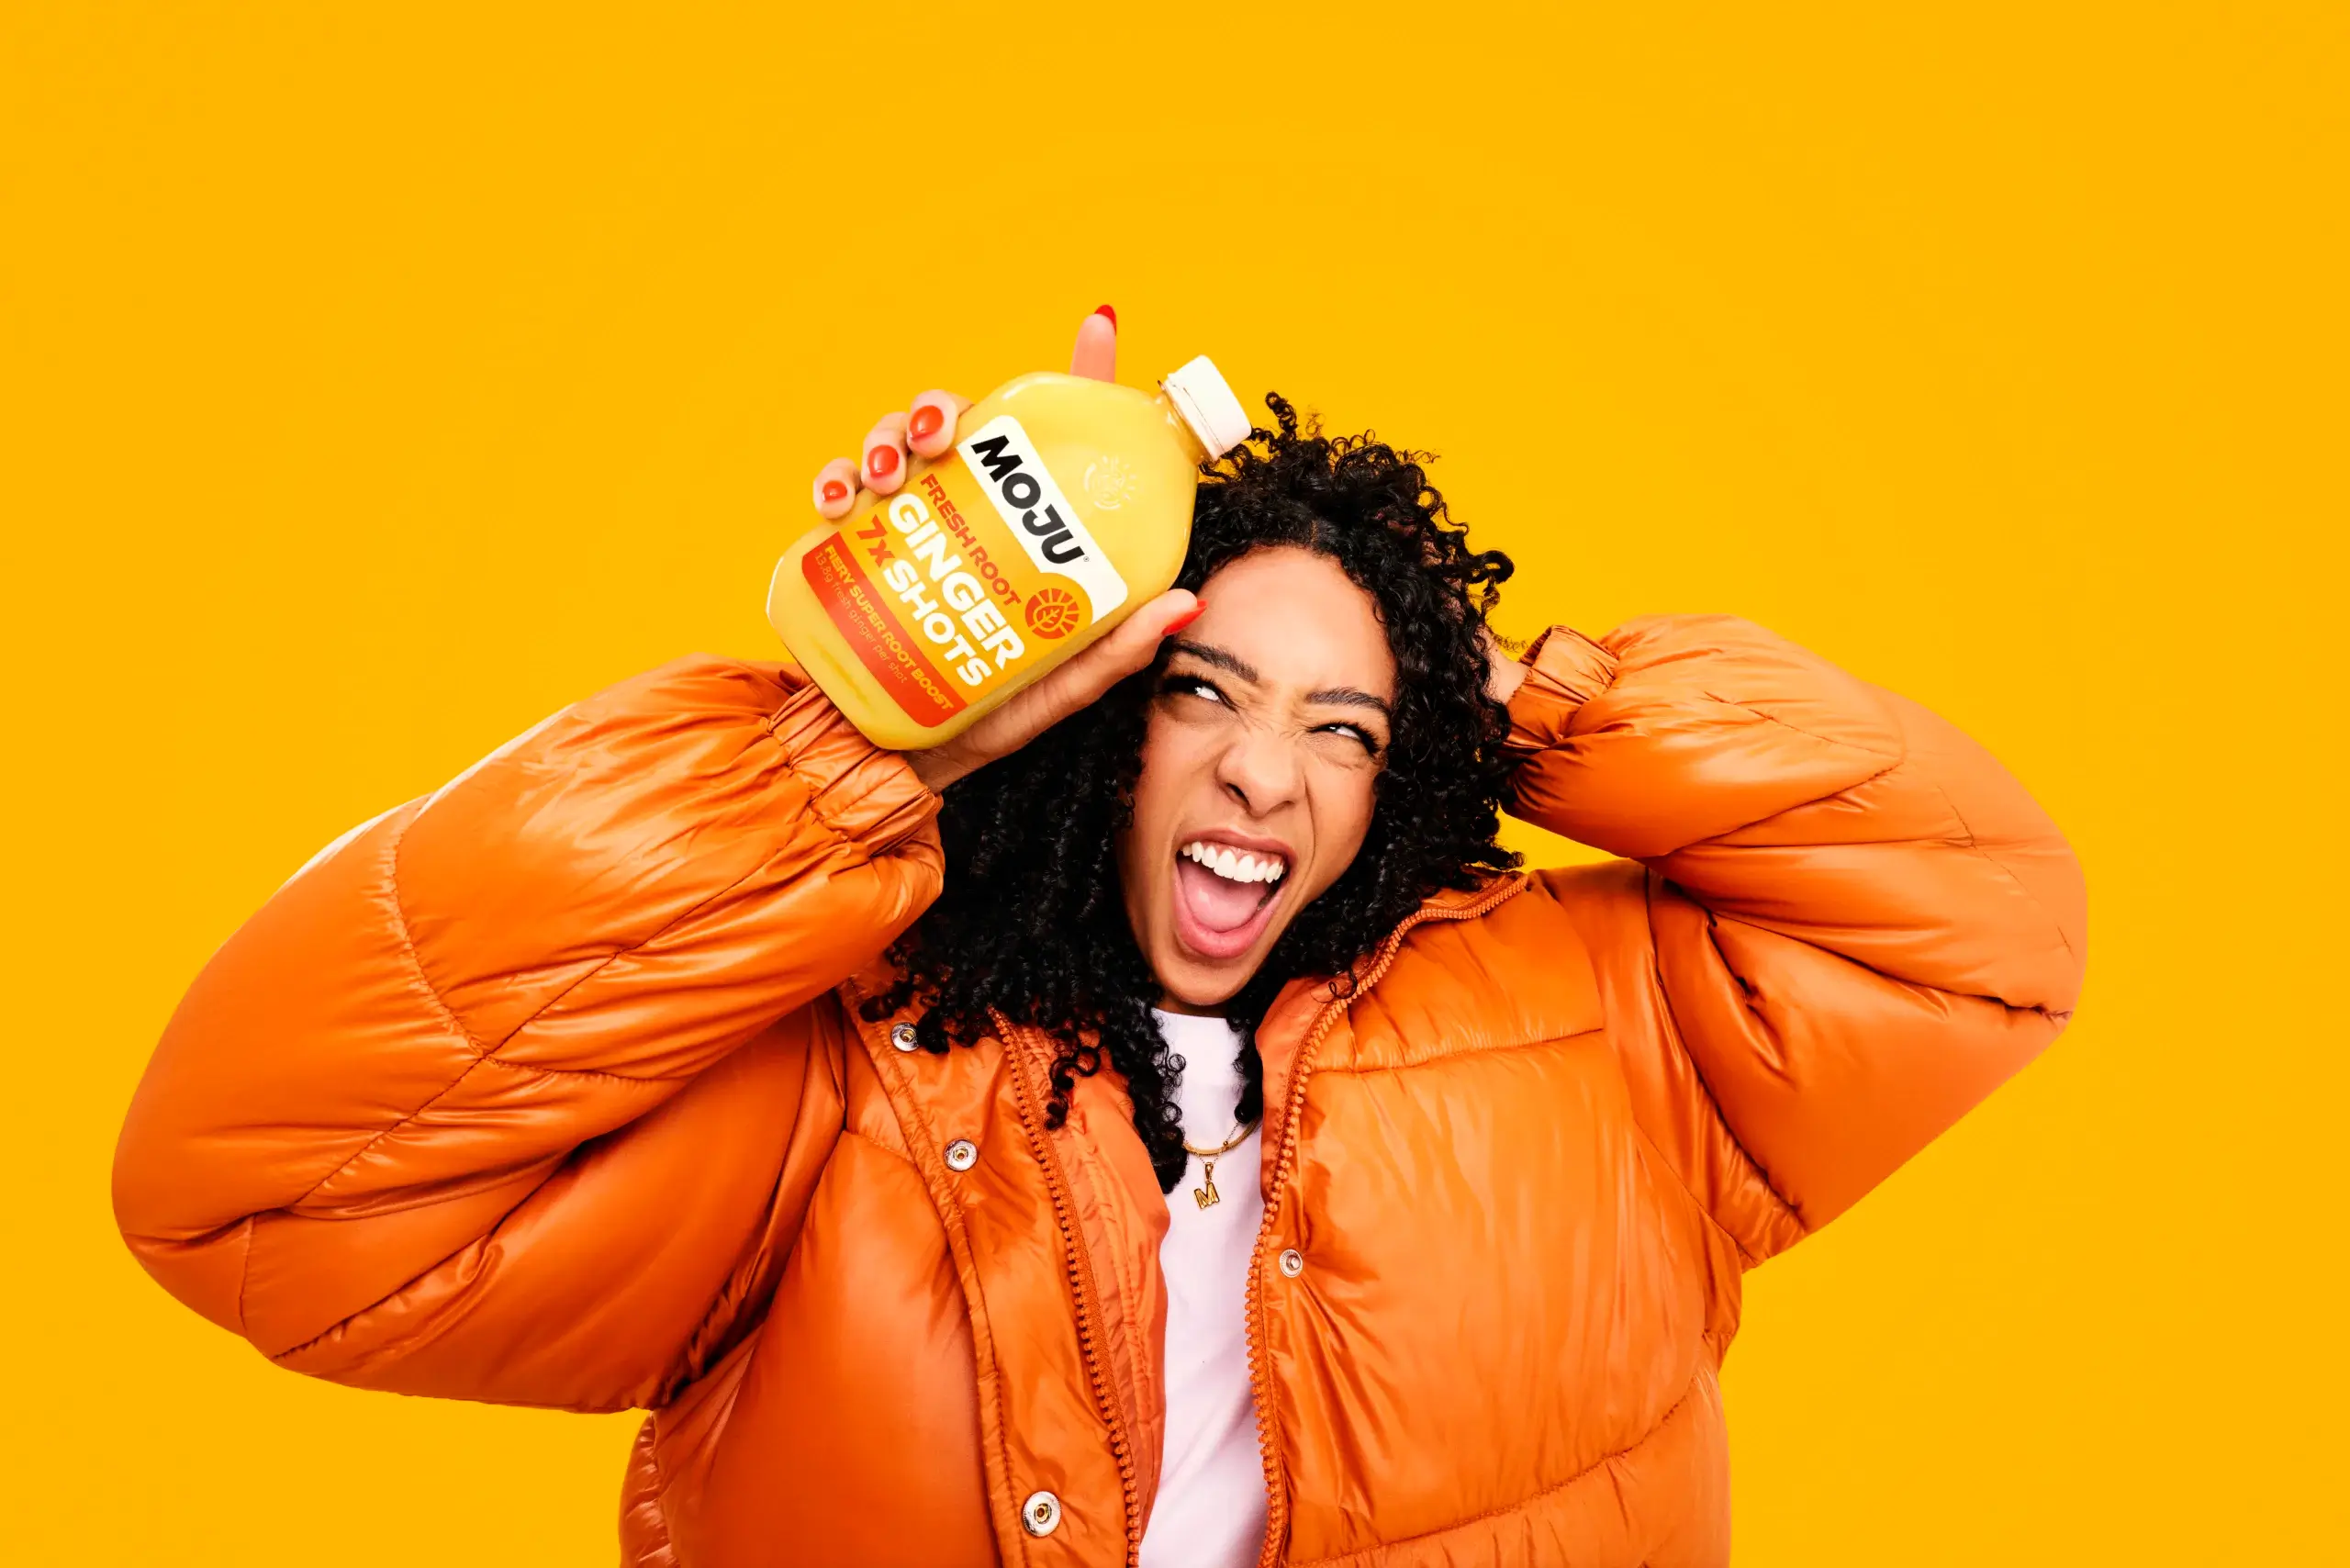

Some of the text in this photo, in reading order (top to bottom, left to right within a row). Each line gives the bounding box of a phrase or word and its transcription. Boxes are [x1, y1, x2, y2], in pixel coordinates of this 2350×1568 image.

[920, 473, 1022, 607] FRESH ROOT
[970, 434, 1085, 564] MOJU
[825, 543, 954, 710] FIERY SUPER ROOT BOOST
[832, 582, 852, 610] fresh
[848, 610, 877, 644] ginger
[873, 644, 890, 662] per
[888, 661, 908, 683] shot
[856, 514, 992, 687] 7x SHOTS
[888, 493, 1025, 670] GINGER
